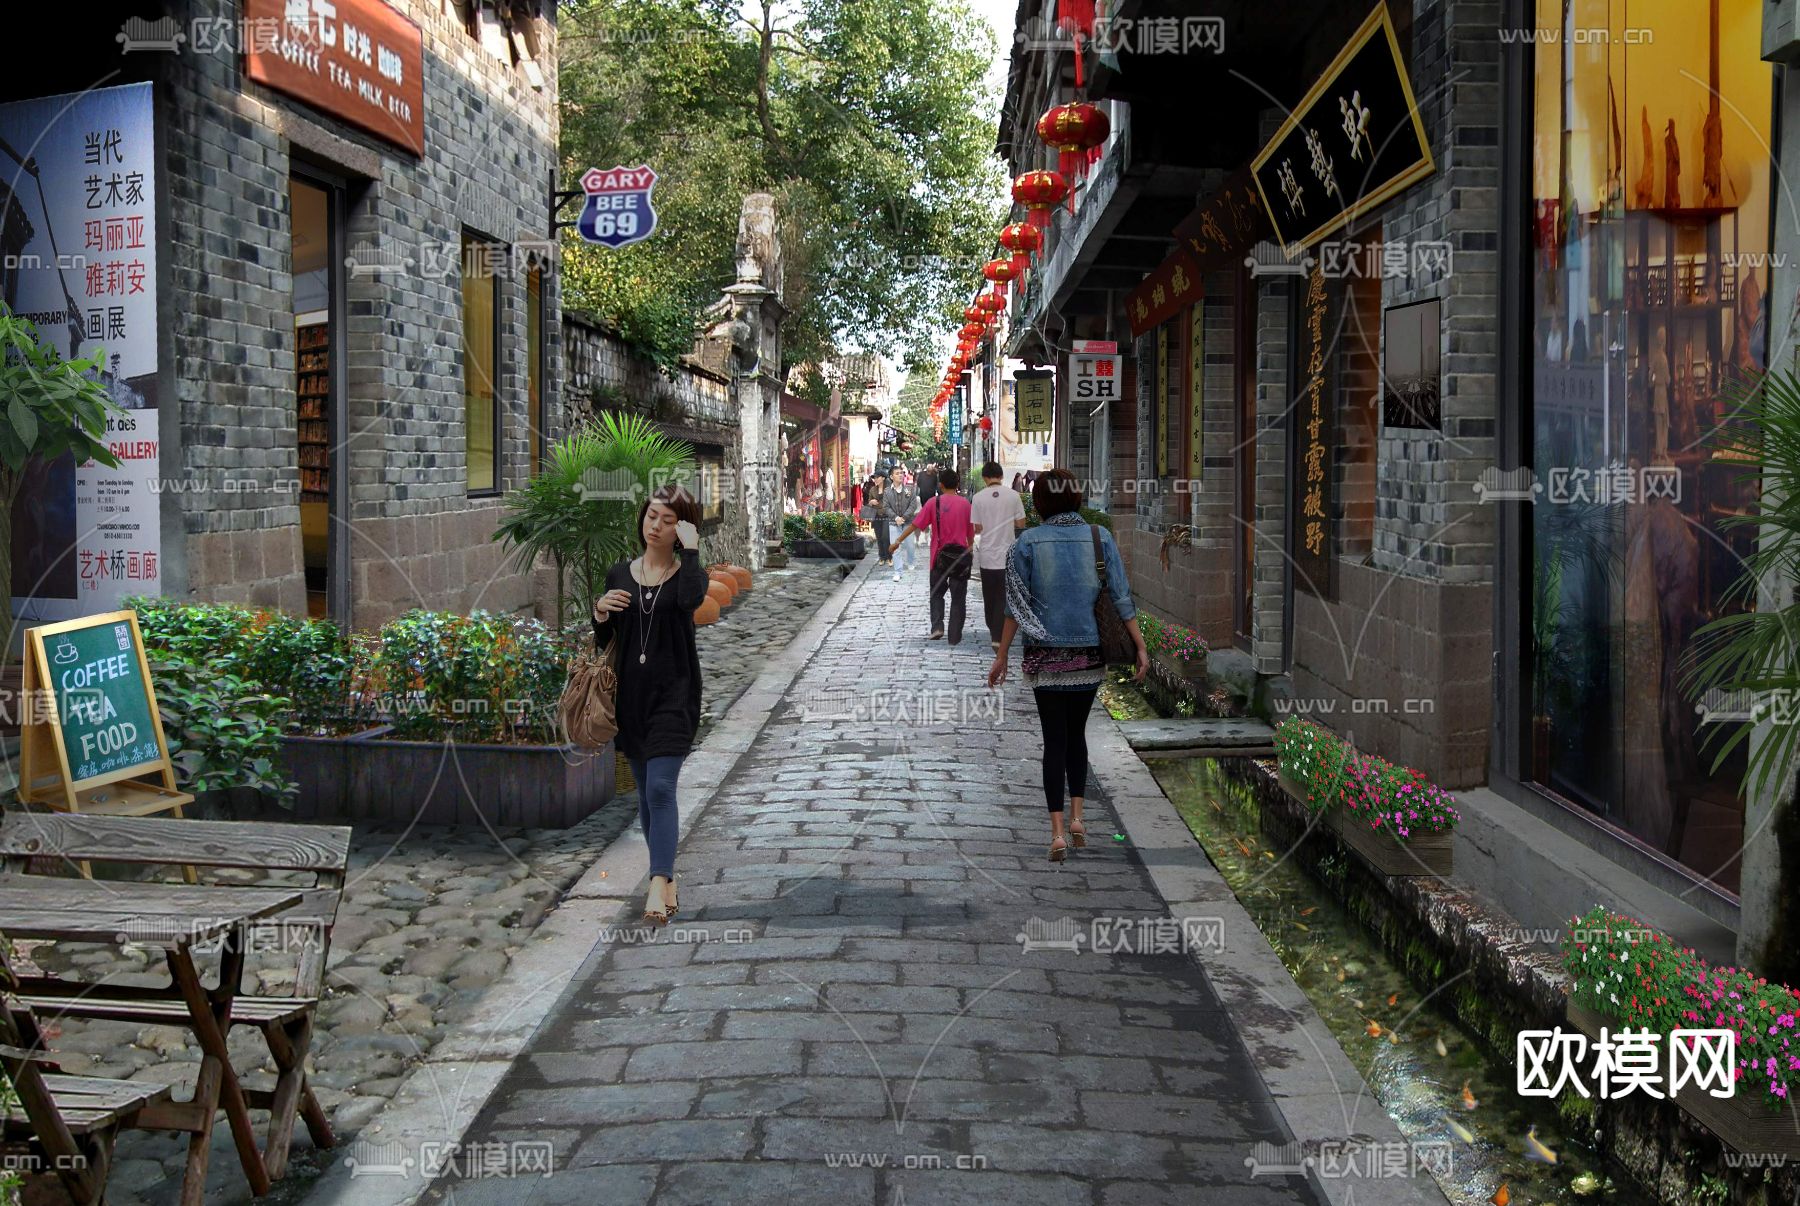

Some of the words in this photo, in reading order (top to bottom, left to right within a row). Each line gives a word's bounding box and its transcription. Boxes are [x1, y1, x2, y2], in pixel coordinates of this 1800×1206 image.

[327, 60, 352, 92] TEA
[358, 77, 383, 108] MILK
[84, 129, 123, 165] 当代
[84, 171, 144, 209] 艺术家
[586, 172, 650, 190] GARY
[596, 194, 638, 211] BEE
[85, 215, 145, 252] 玛丽亚
[594, 211, 638, 237] 69
[86, 259, 146, 298] 雅莉安
[87, 305, 126, 342] 画展
[1077, 359, 1093, 377] I
[1077, 380, 1115, 398] SH
[109, 441, 158, 460] GALLERY
[79, 549, 158, 581] 艺术桥画廊
[62, 653, 130, 693] COFFEE
[70, 695, 117, 726] TEA
[80, 722, 137, 761] FOOD
